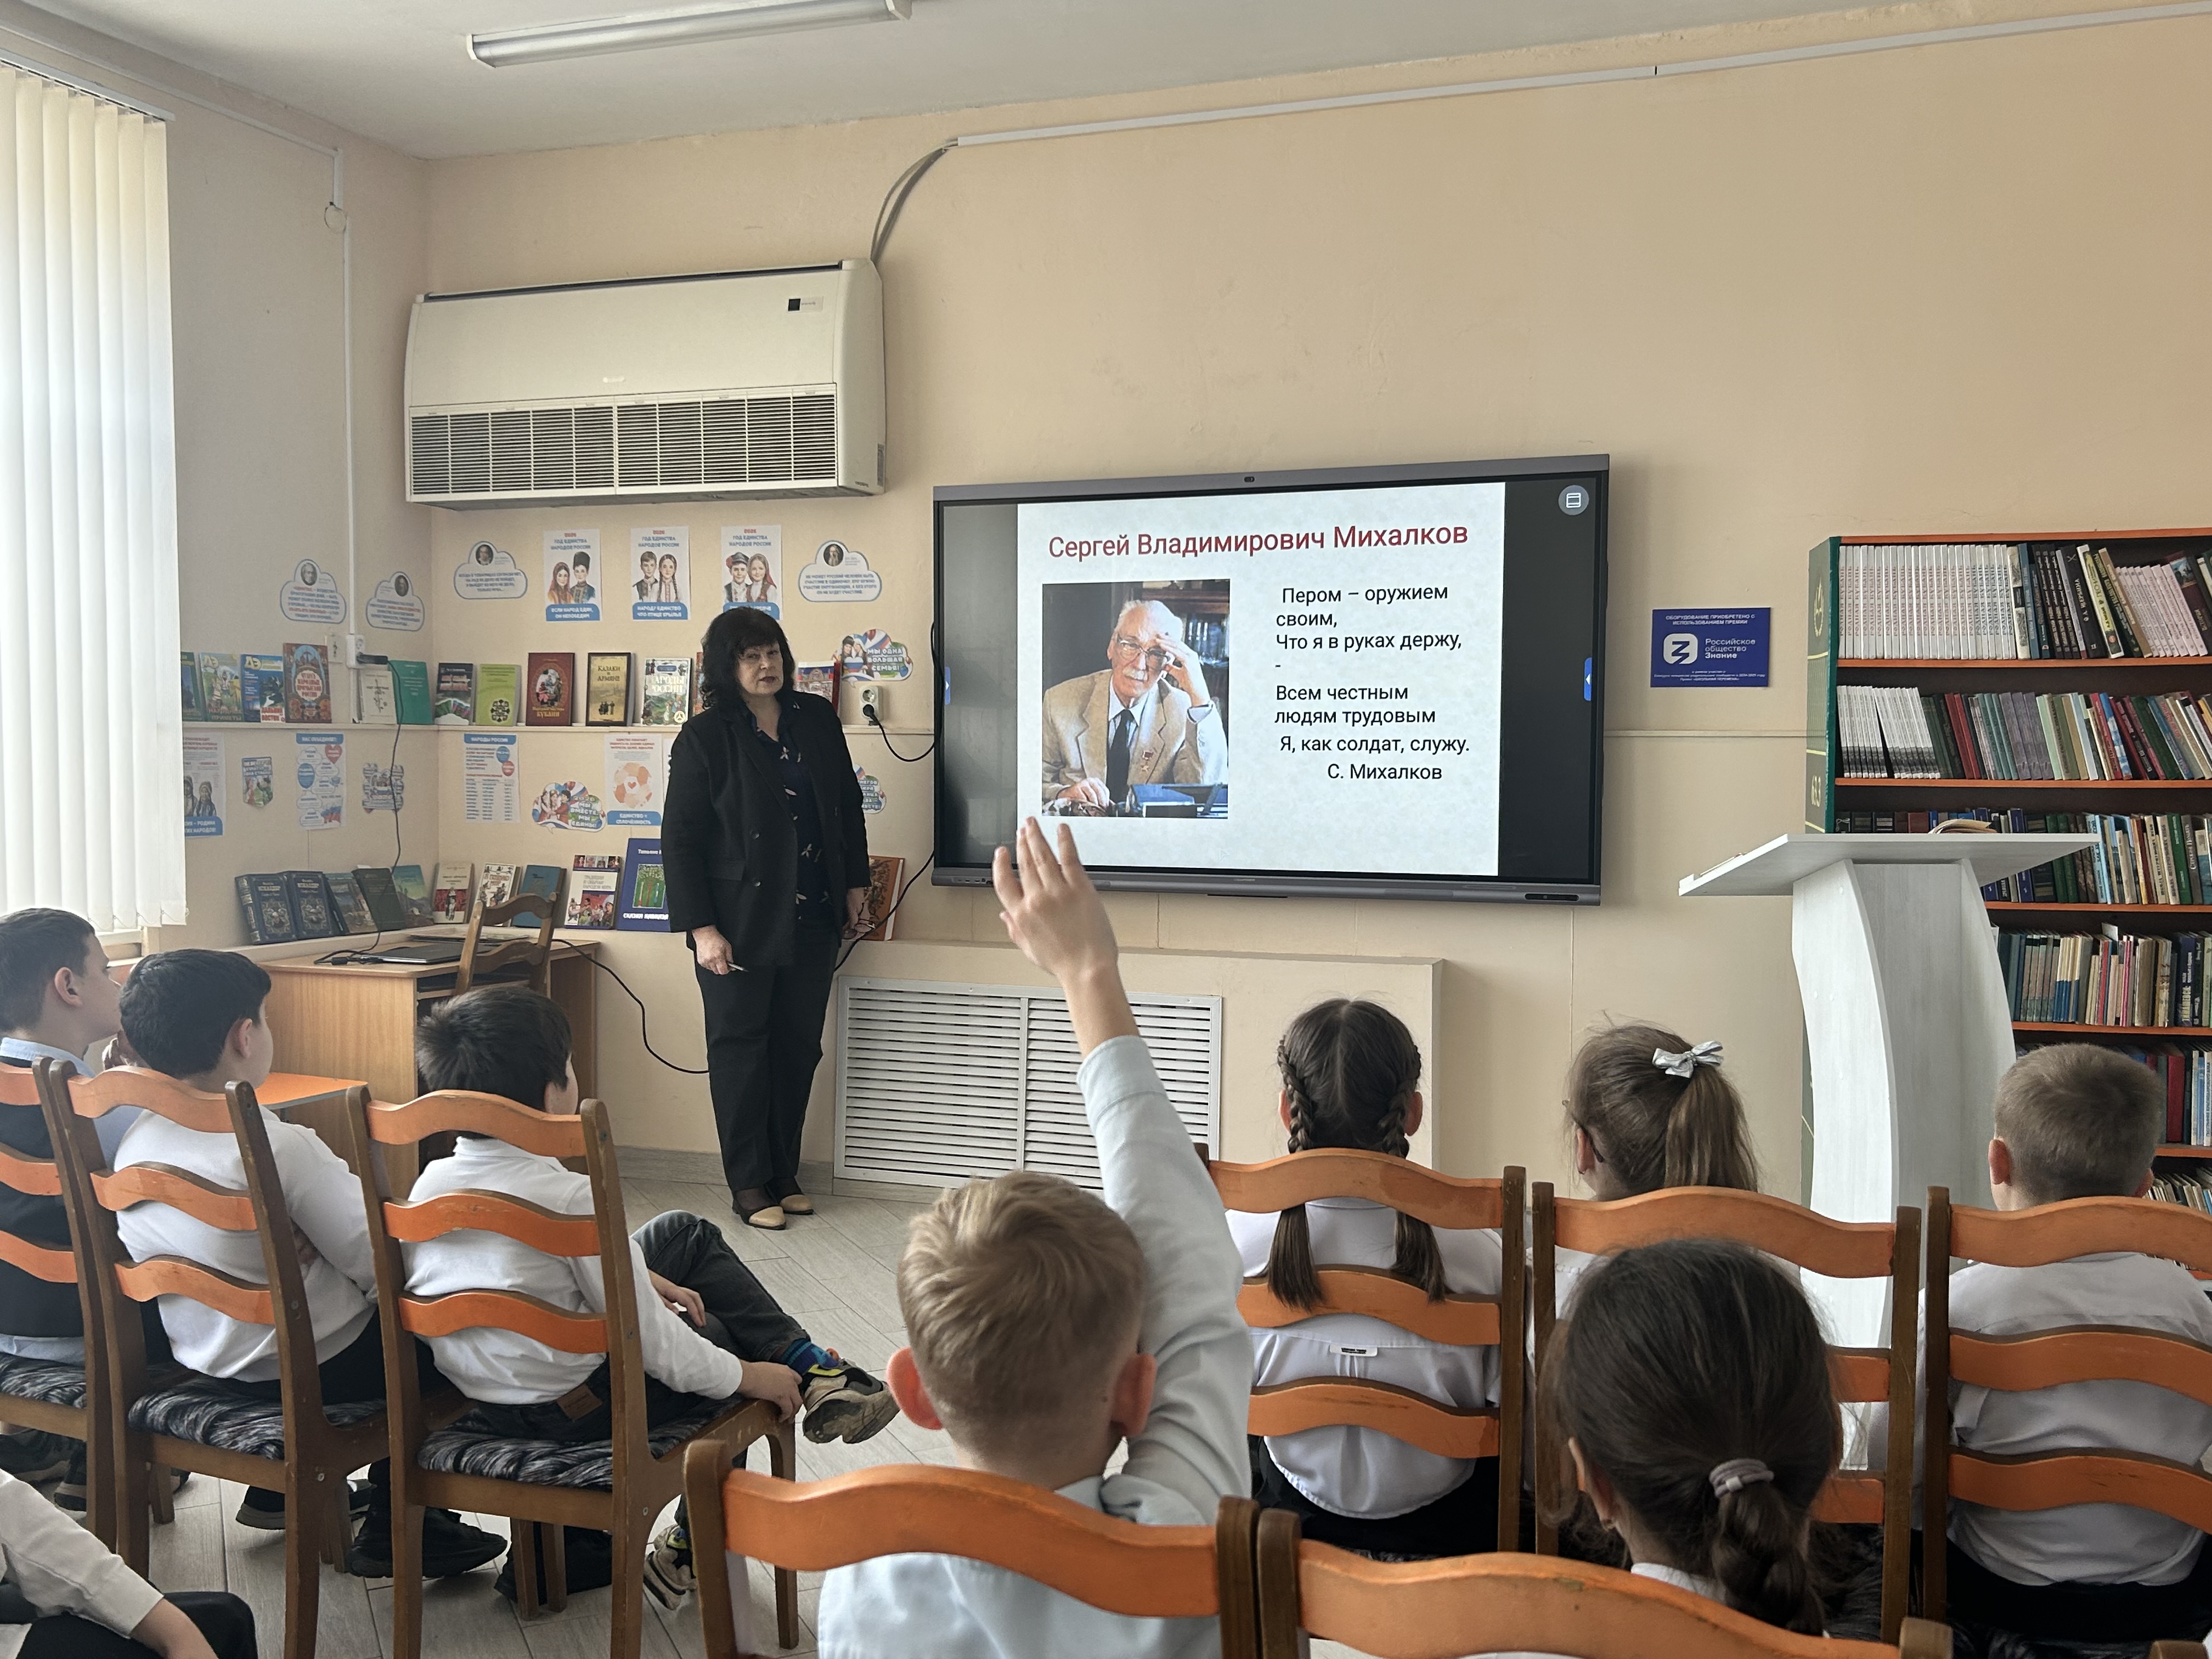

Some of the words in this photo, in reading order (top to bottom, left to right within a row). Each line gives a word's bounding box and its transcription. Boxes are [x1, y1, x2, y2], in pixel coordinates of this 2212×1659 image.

[1049, 534, 1130, 562] Сергей
[1137, 532, 1324, 558] Владимирович
[1334, 525, 1468, 548] Михалков
[1282, 588, 1342, 606] Пером
[1364, 586, 1448, 605] оружием
[2074, 578, 2086, 609] ЩЕРБИНА
[1276, 613, 1338, 628] своим,
[1276, 634, 1308, 650] Что
[1312, 636, 1323, 649] я
[1328, 636, 1339, 649] в
[1344, 634, 1395, 652] руках
[1399, 634, 1462, 651] держу,
[652, 675, 685, 685] АРОДЫ
[1276, 685, 1322, 701] Всем
[1327, 687, 1409, 700] честным
[1274, 711, 1337, 726] людям
[1342, 710, 1436, 727] трудовым
[1280, 735, 1296, 753] Я,
[1301, 738, 1332, 751] как
[1336, 738, 1404, 754] солдат,
[1410, 738, 1470, 755] служу.
[1327, 763, 1344, 779] С.
[1350, 763, 1443, 780] Михалков
